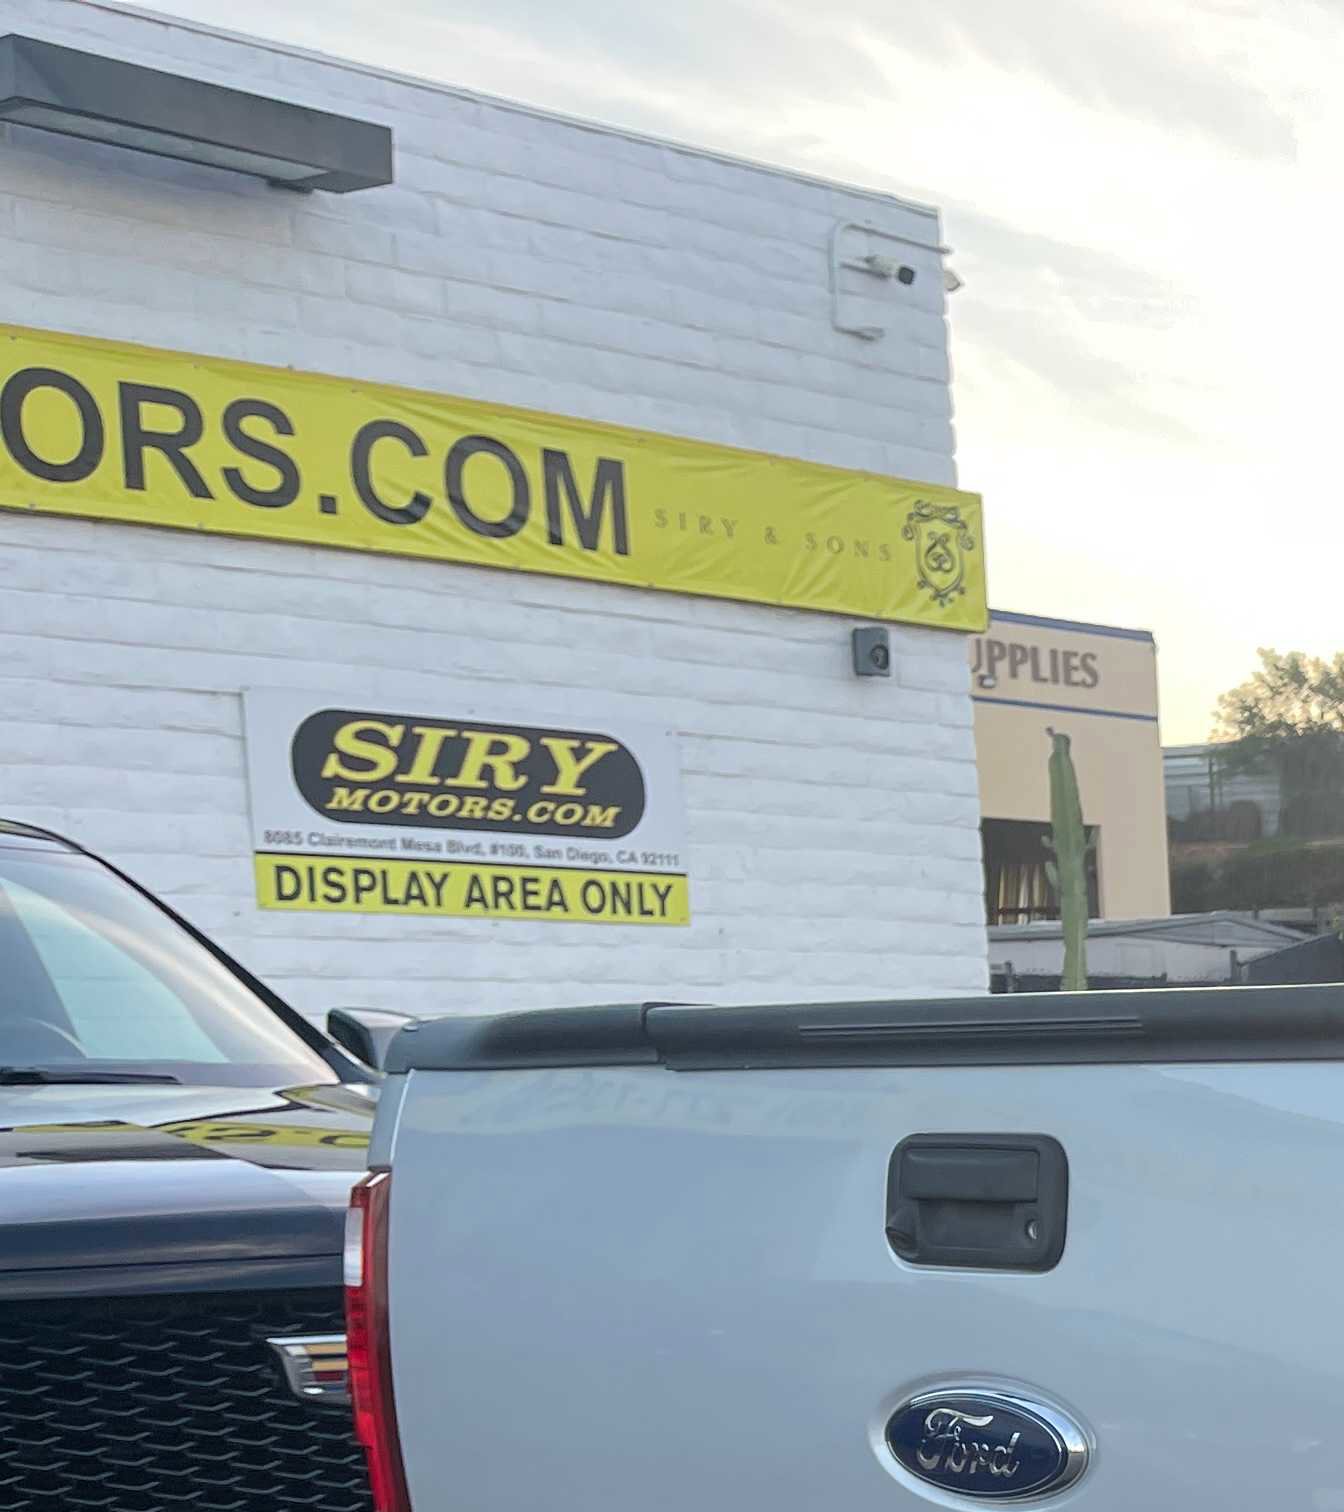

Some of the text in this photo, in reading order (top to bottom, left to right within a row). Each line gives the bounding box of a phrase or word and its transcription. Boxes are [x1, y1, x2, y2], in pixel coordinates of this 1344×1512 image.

[0, 366, 628, 556] ORS.COM
[654, 508, 738, 538] SIRY
[804, 531, 892, 562] SONS
[320, 719, 618, 796] SIRY
[326, 786, 622, 828] MOTORS.COM
[616, 852, 638, 865] CA
[273, 864, 673, 917] DISPLAY AREA ONLY
[916, 1407, 1021, 1478] Ford
